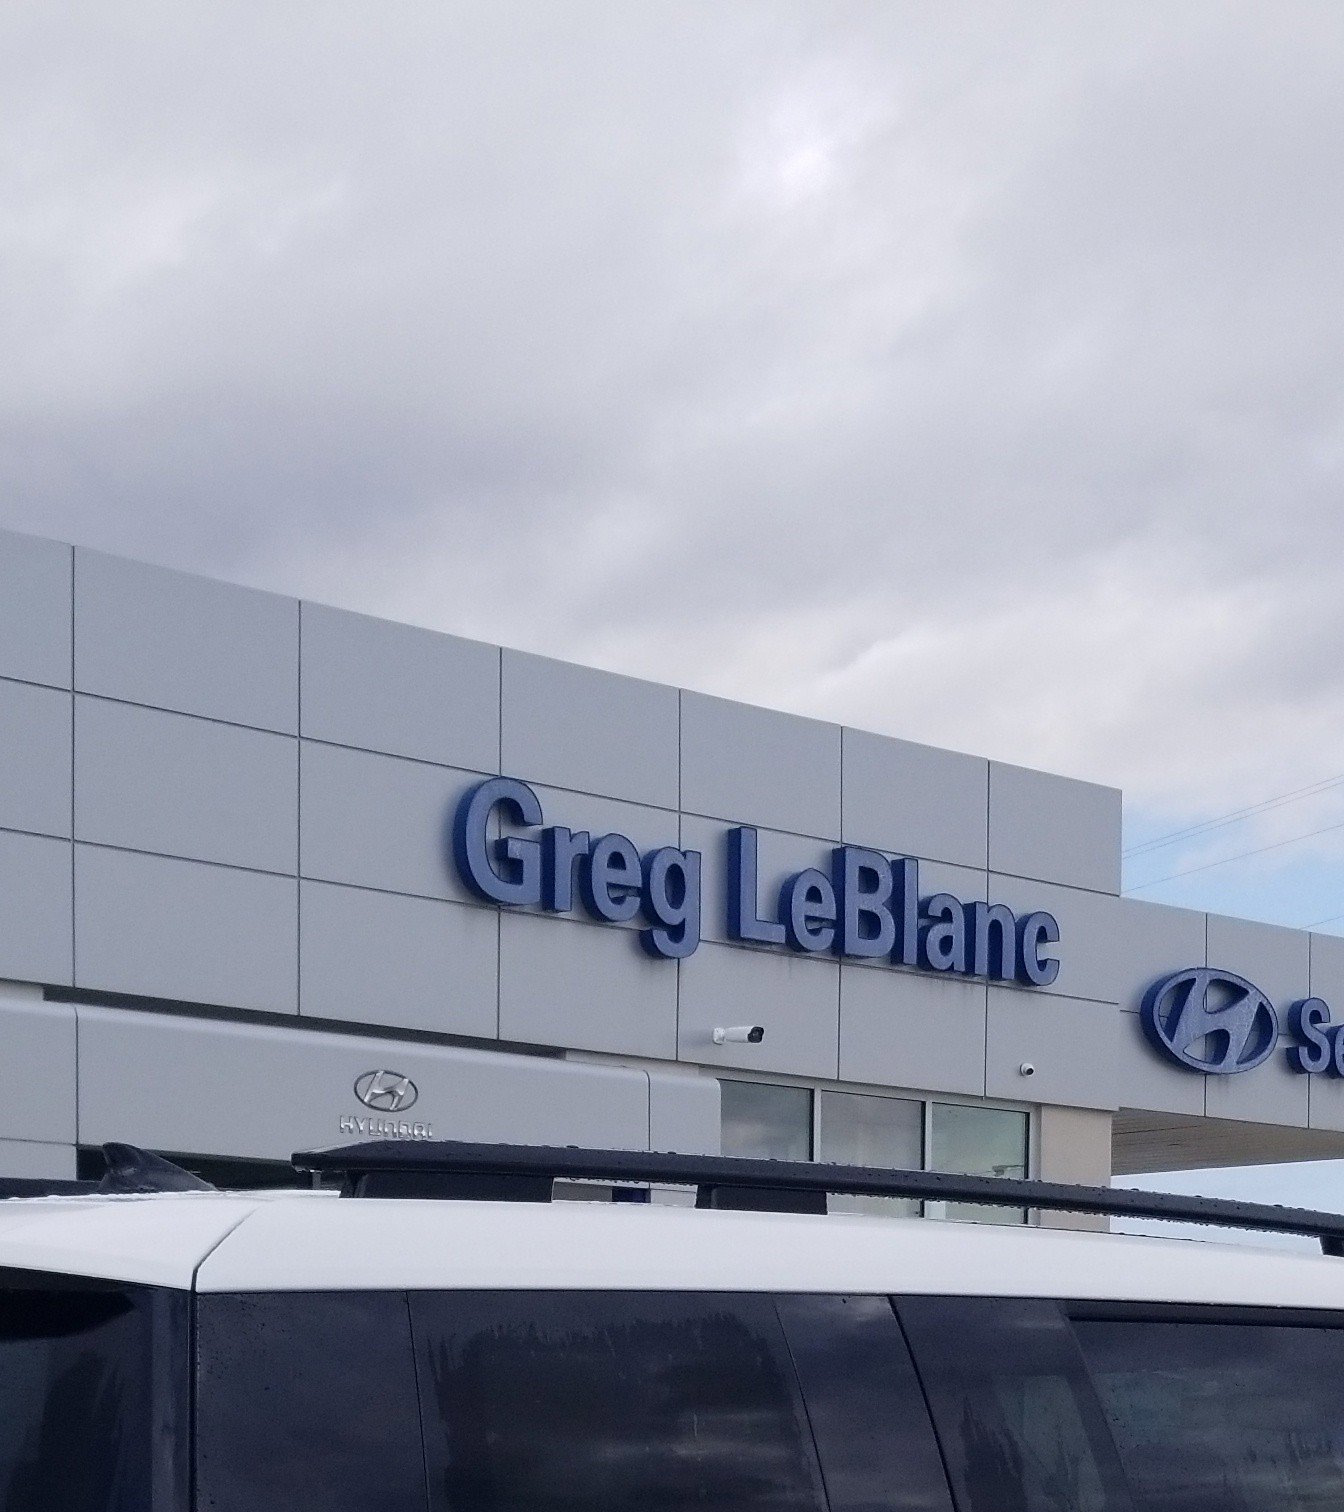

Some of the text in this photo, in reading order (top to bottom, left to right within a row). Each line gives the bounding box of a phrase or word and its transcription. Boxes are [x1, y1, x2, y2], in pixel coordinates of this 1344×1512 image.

[453, 776, 1060, 986] Greg LeBlanc
[339, 1115, 433, 1139] HYUNDAI
